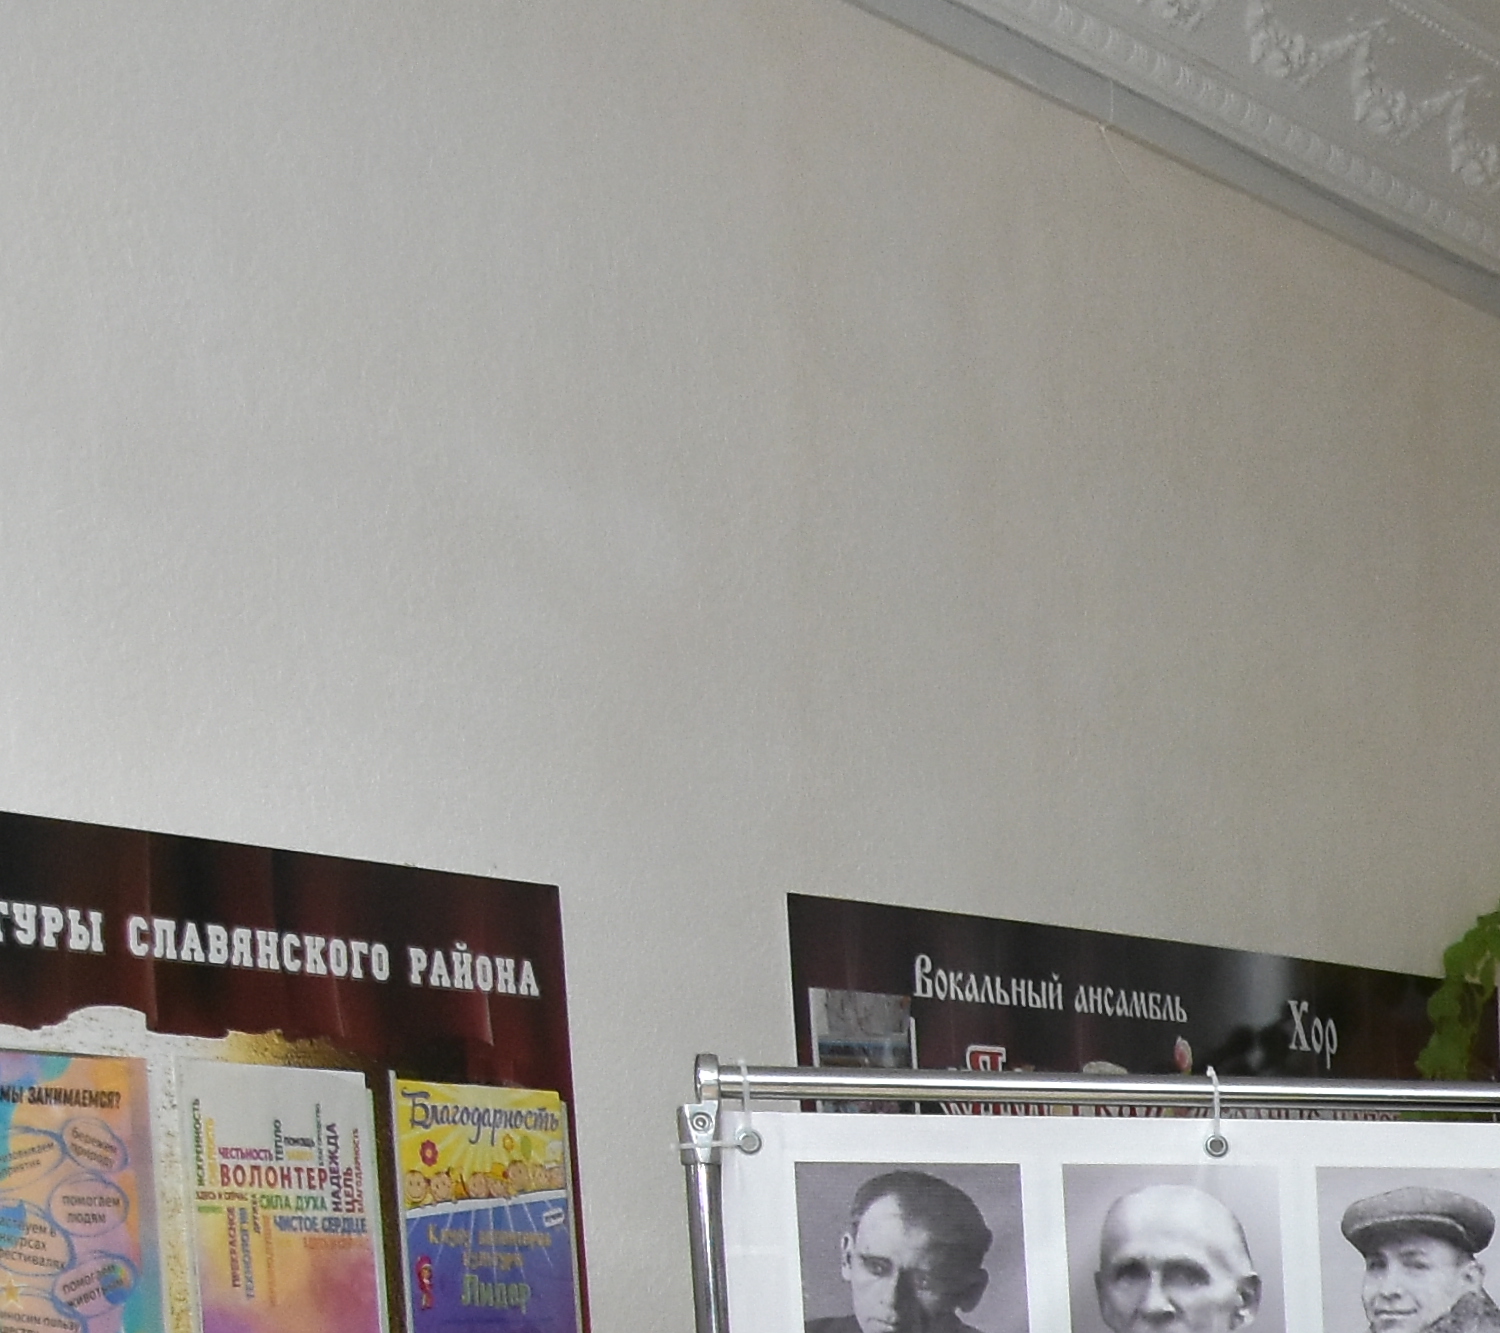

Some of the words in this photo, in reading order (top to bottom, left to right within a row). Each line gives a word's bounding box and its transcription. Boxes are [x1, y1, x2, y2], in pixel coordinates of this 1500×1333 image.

[126, 915, 390, 981] СЛАВЯНСКОГО
[408, 943, 539, 996] РАЙОНА
[913, 954, 1063, 1010] Вокальный
[1074, 984, 1187, 1023] ансамбль
[1287, 999, 1340, 1071] Хор
[400, 1086, 561, 1146] Благодарность
[219, 1164, 329, 1191] ВОЛОНТЕР
[326, 1122, 344, 1213] НАДЕЖДА
[343, 1167, 357, 1214] ЦЕЛЬ
